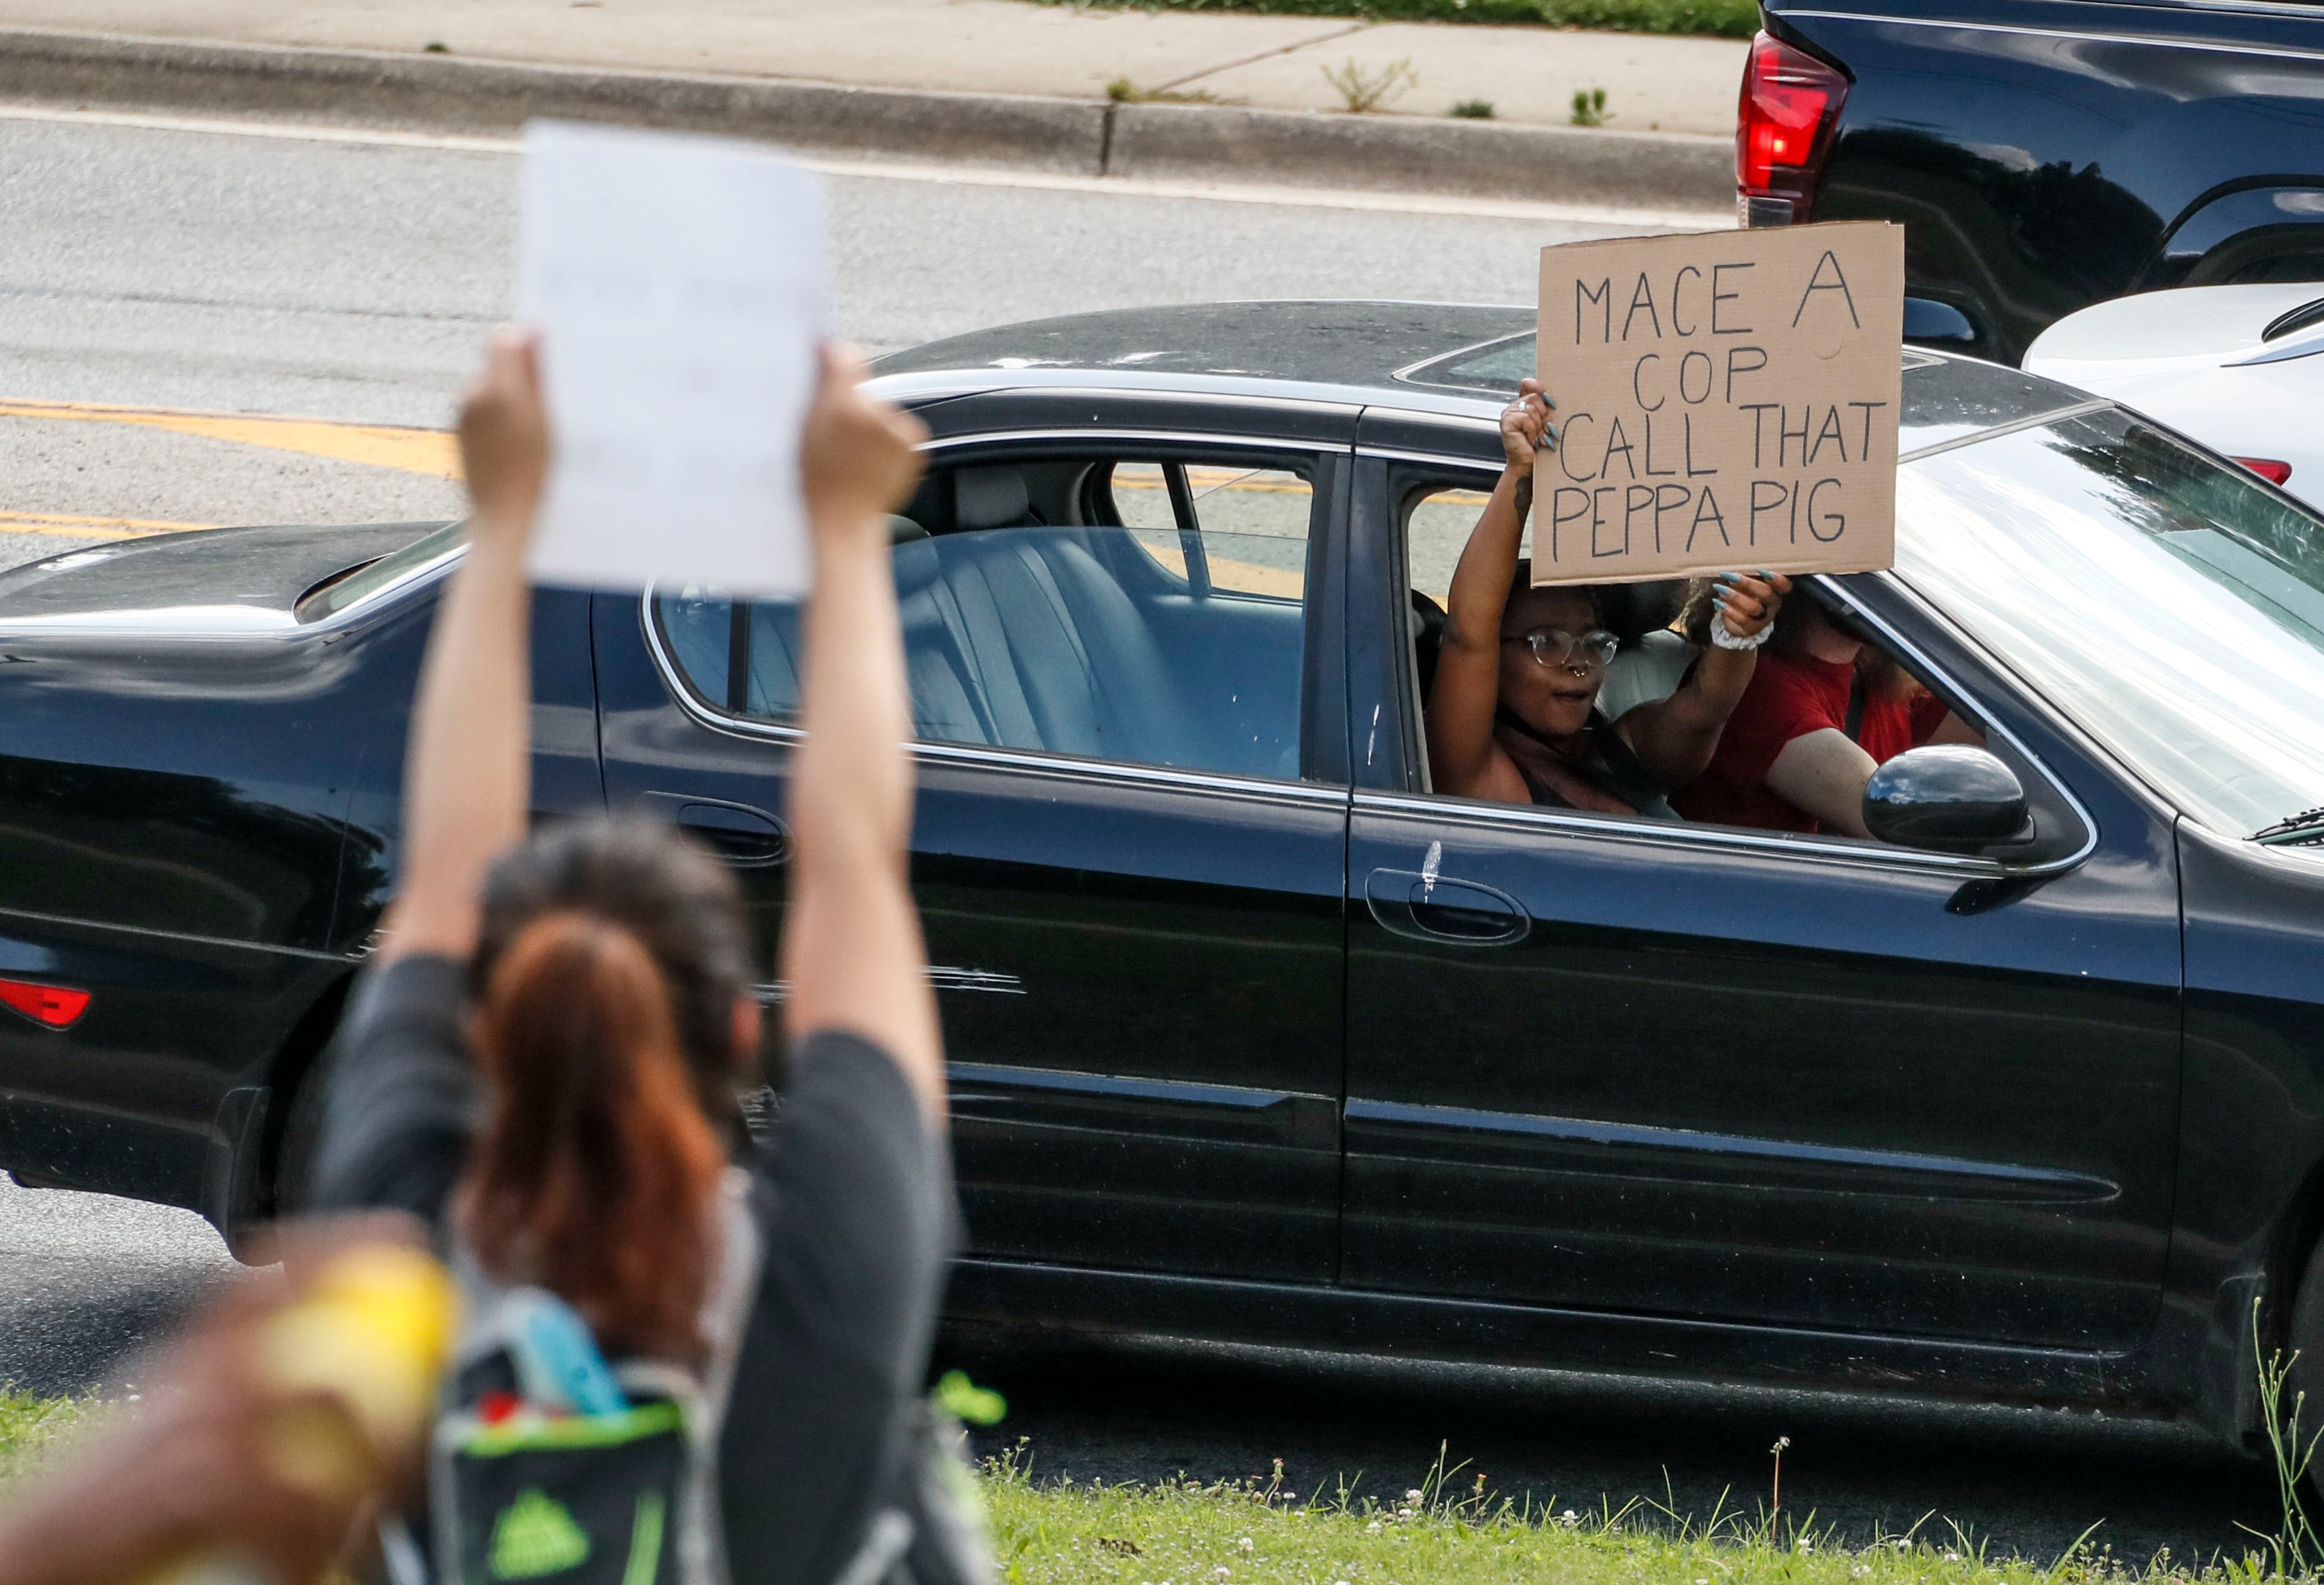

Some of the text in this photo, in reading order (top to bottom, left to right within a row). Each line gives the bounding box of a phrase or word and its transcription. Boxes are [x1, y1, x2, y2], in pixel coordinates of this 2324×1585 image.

[1575, 250, 1860, 345] MACE A
[1634, 346, 1768, 412] COP
[1559, 401, 1888, 483] CALL THAT
[1552, 477, 1846, 563] PEPPA PIG
